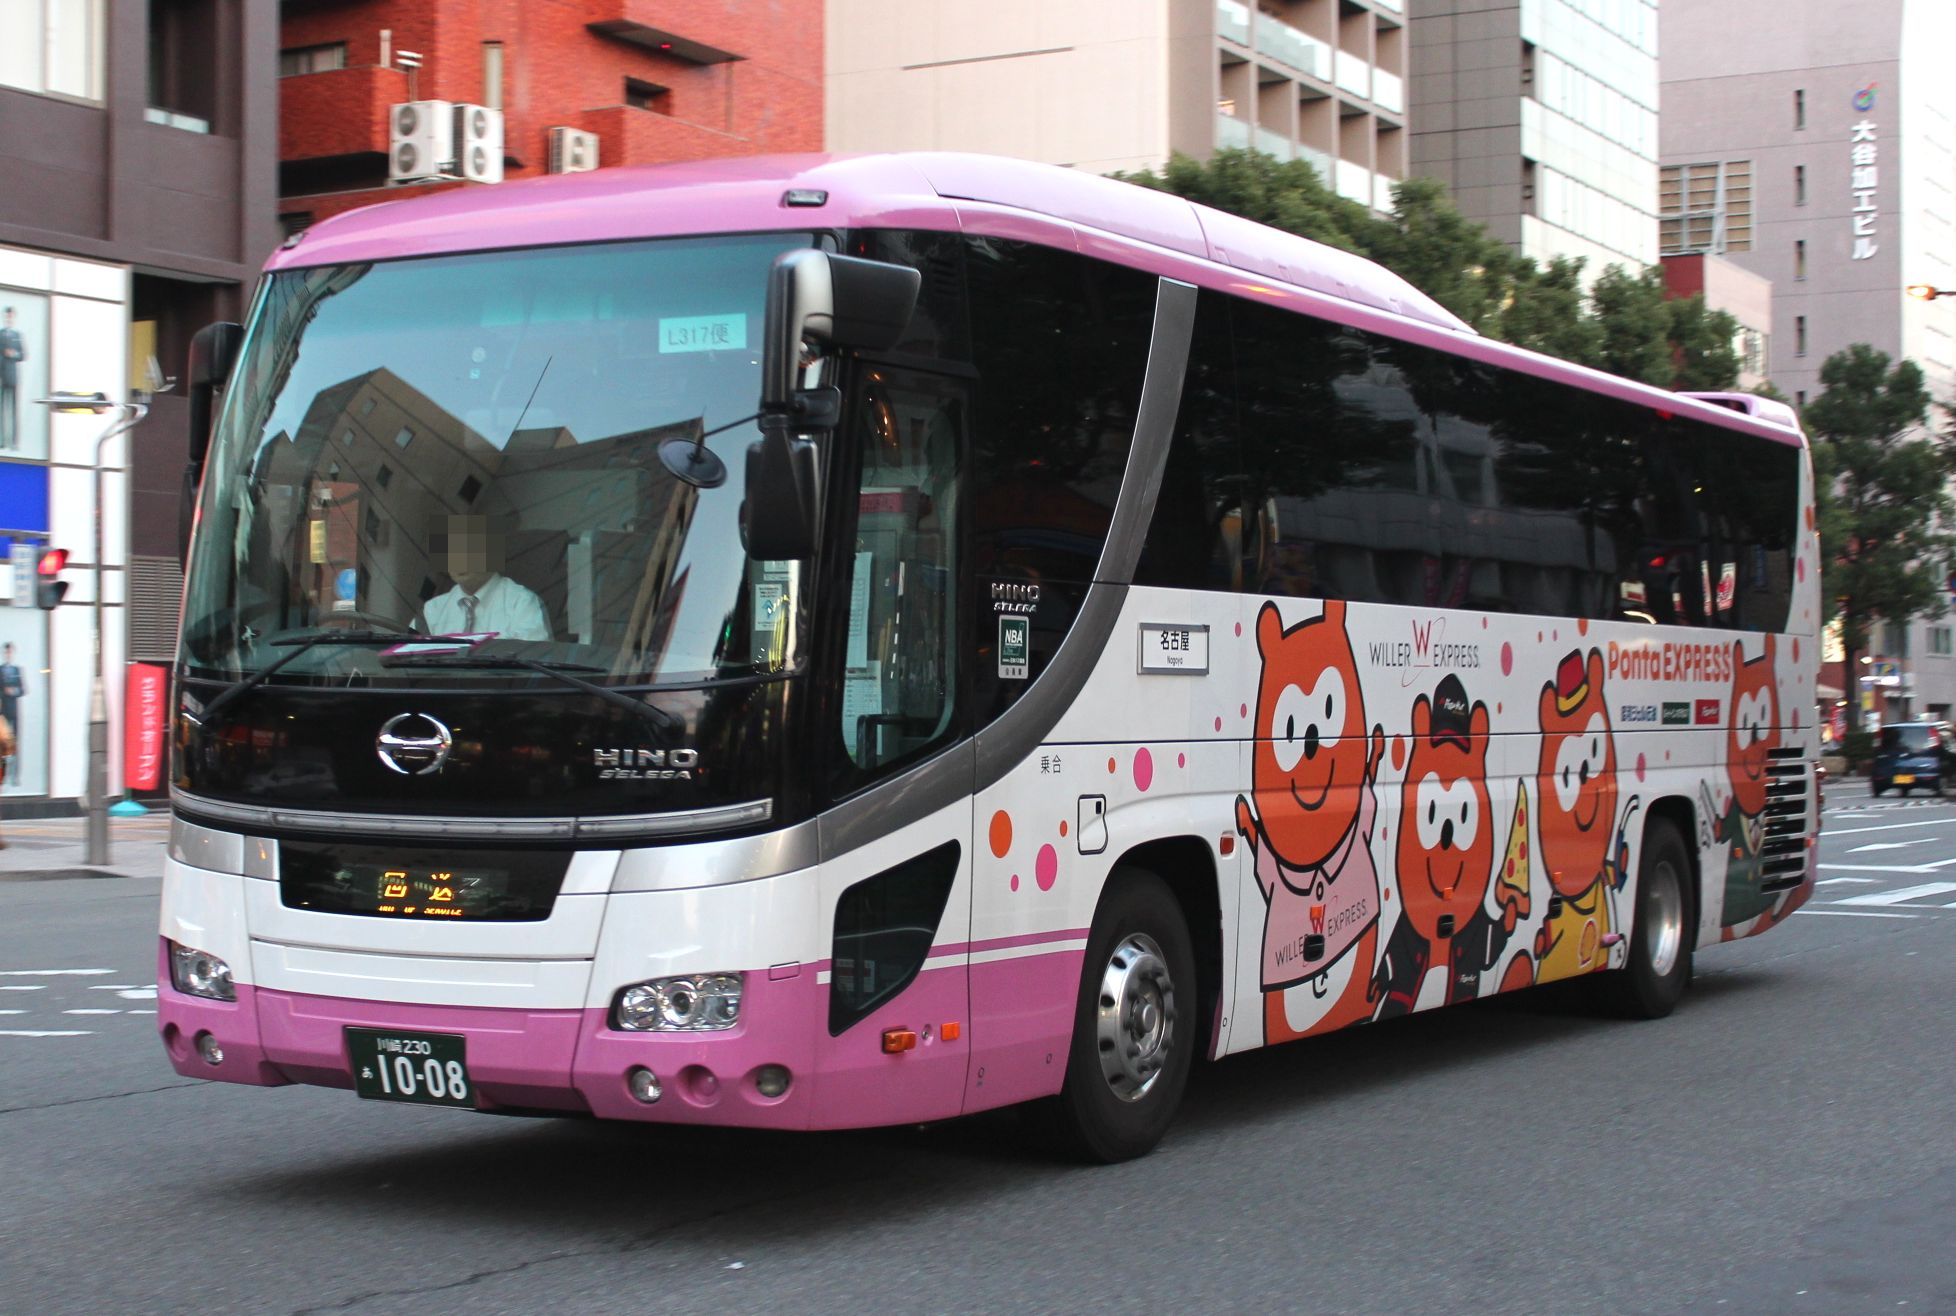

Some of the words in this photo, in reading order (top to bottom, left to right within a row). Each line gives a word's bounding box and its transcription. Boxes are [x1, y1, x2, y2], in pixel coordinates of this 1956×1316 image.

[667, 322, 730, 346] L317便
[991, 582, 1040, 601] HINO
[1005, 629, 1023, 644] NBA
[1161, 630, 1190, 651] 名古屋
[1167, 655, 1183, 667] Nagoya
[1369, 641, 1411, 668] WILLER
[1433, 643, 1480, 668] EXPRESS
[1608, 641, 1660, 681] Ponta
[1662, 641, 1731, 683] EXPRESS
[593, 748, 698, 767] HINO
[1041, 754, 1061, 774] 乗合
[1327, 898, 1368, 937] EXPRESS
[377, 1055, 468, 1100] 10-08
